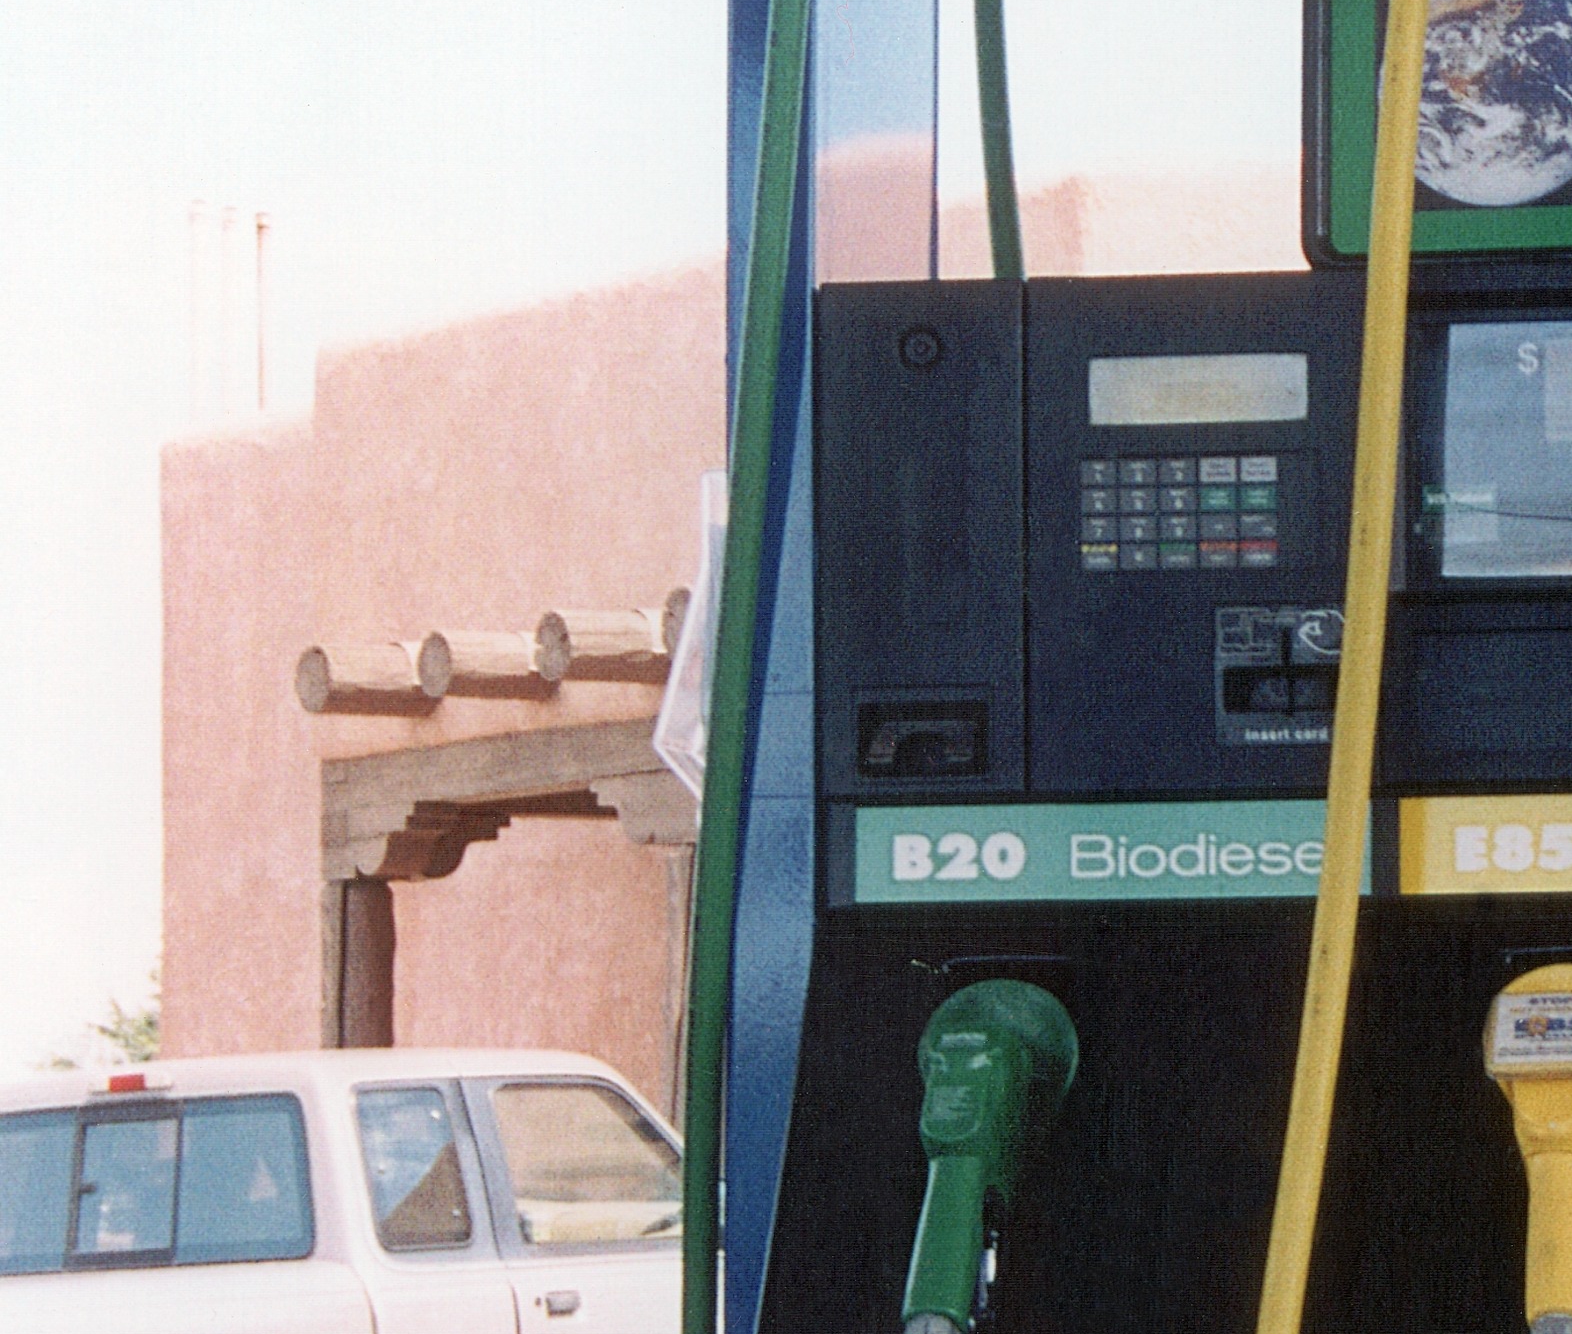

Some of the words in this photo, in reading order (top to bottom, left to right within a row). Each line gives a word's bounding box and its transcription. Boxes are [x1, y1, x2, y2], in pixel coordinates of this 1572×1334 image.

[1518, 341, 1539, 375] $
[893, 832, 1027, 880] B20
[1070, 834, 1326, 878] Biodiese
